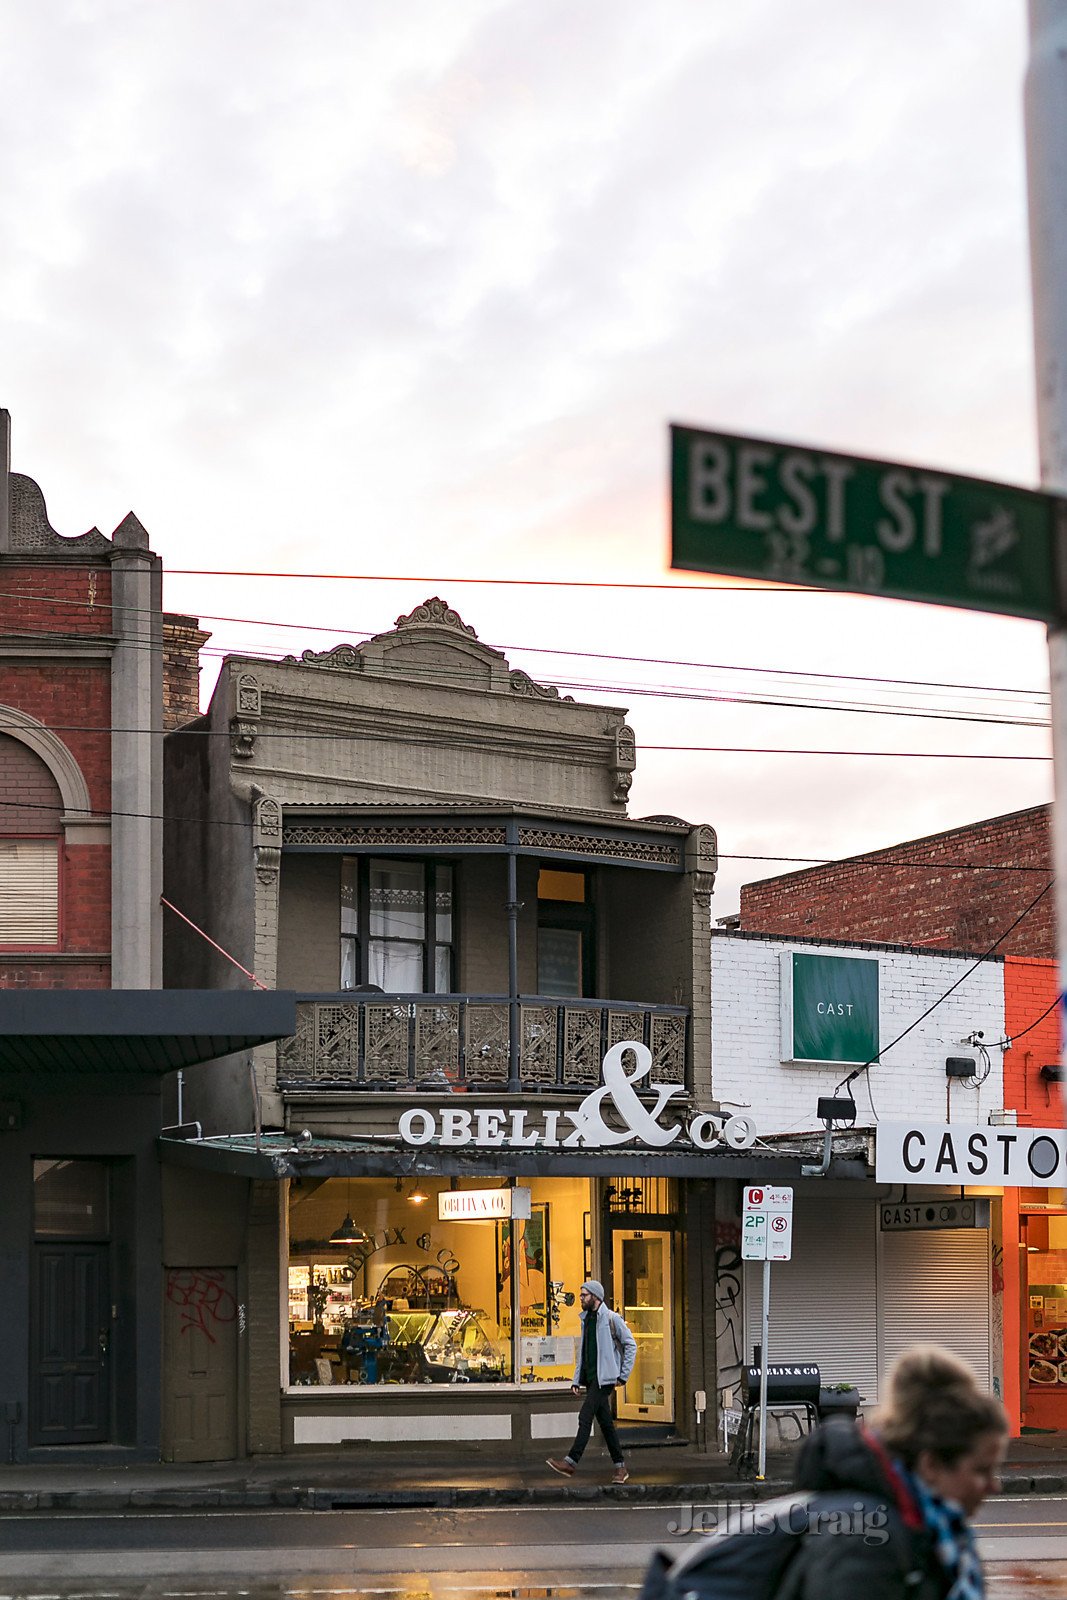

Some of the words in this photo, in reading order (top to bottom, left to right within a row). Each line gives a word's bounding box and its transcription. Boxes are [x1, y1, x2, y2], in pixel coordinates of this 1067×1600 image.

[687, 437, 852, 542] BEST
[875, 469, 951, 557] ST
[817, 1002, 854, 1016] CAST
[398, 1108, 600, 1147] OBELIX
[577, 1040, 685, 1147] &
[745, 1216, 765, 1228] 2P
[803, 1367, 819, 1375] CO
